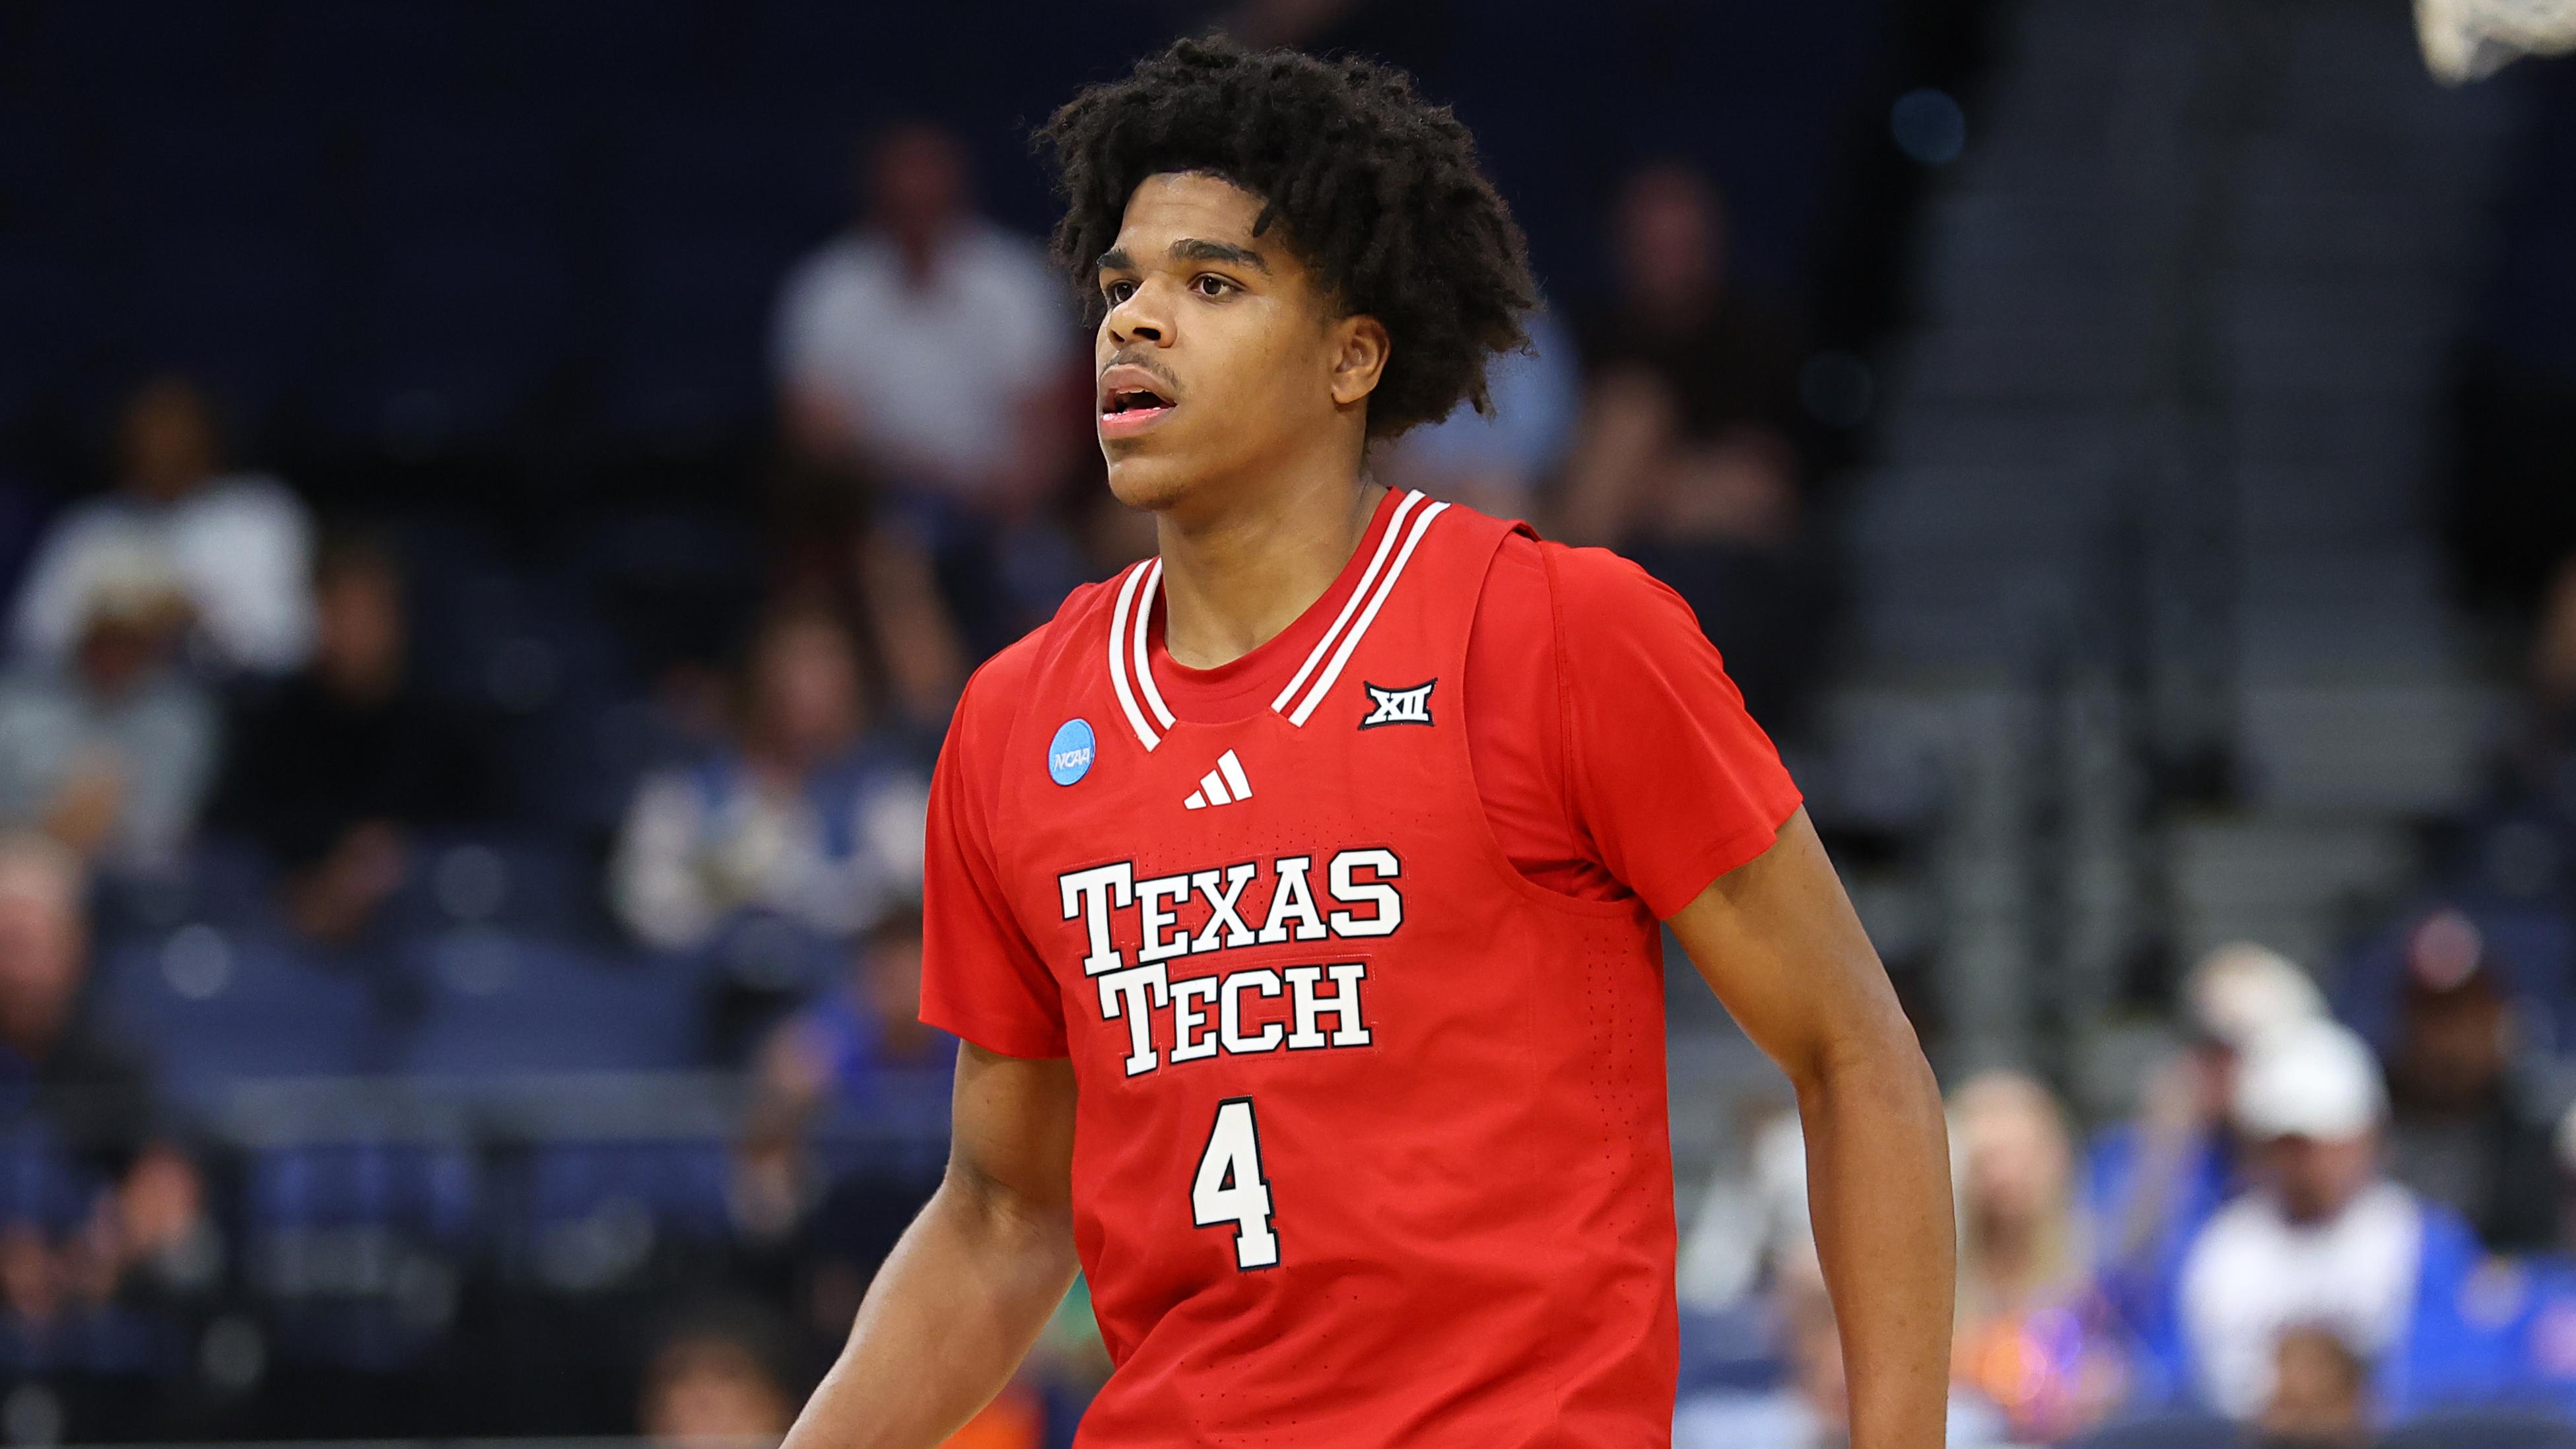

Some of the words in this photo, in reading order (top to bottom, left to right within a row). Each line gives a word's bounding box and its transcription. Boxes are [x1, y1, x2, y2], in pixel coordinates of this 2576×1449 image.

[1054, 747, 1091, 771] NCAA
[1058, 848, 1404, 976] TEXAS
[1097, 962, 1373, 1077] TECH
[1190, 1097, 1280, 1271] 4
